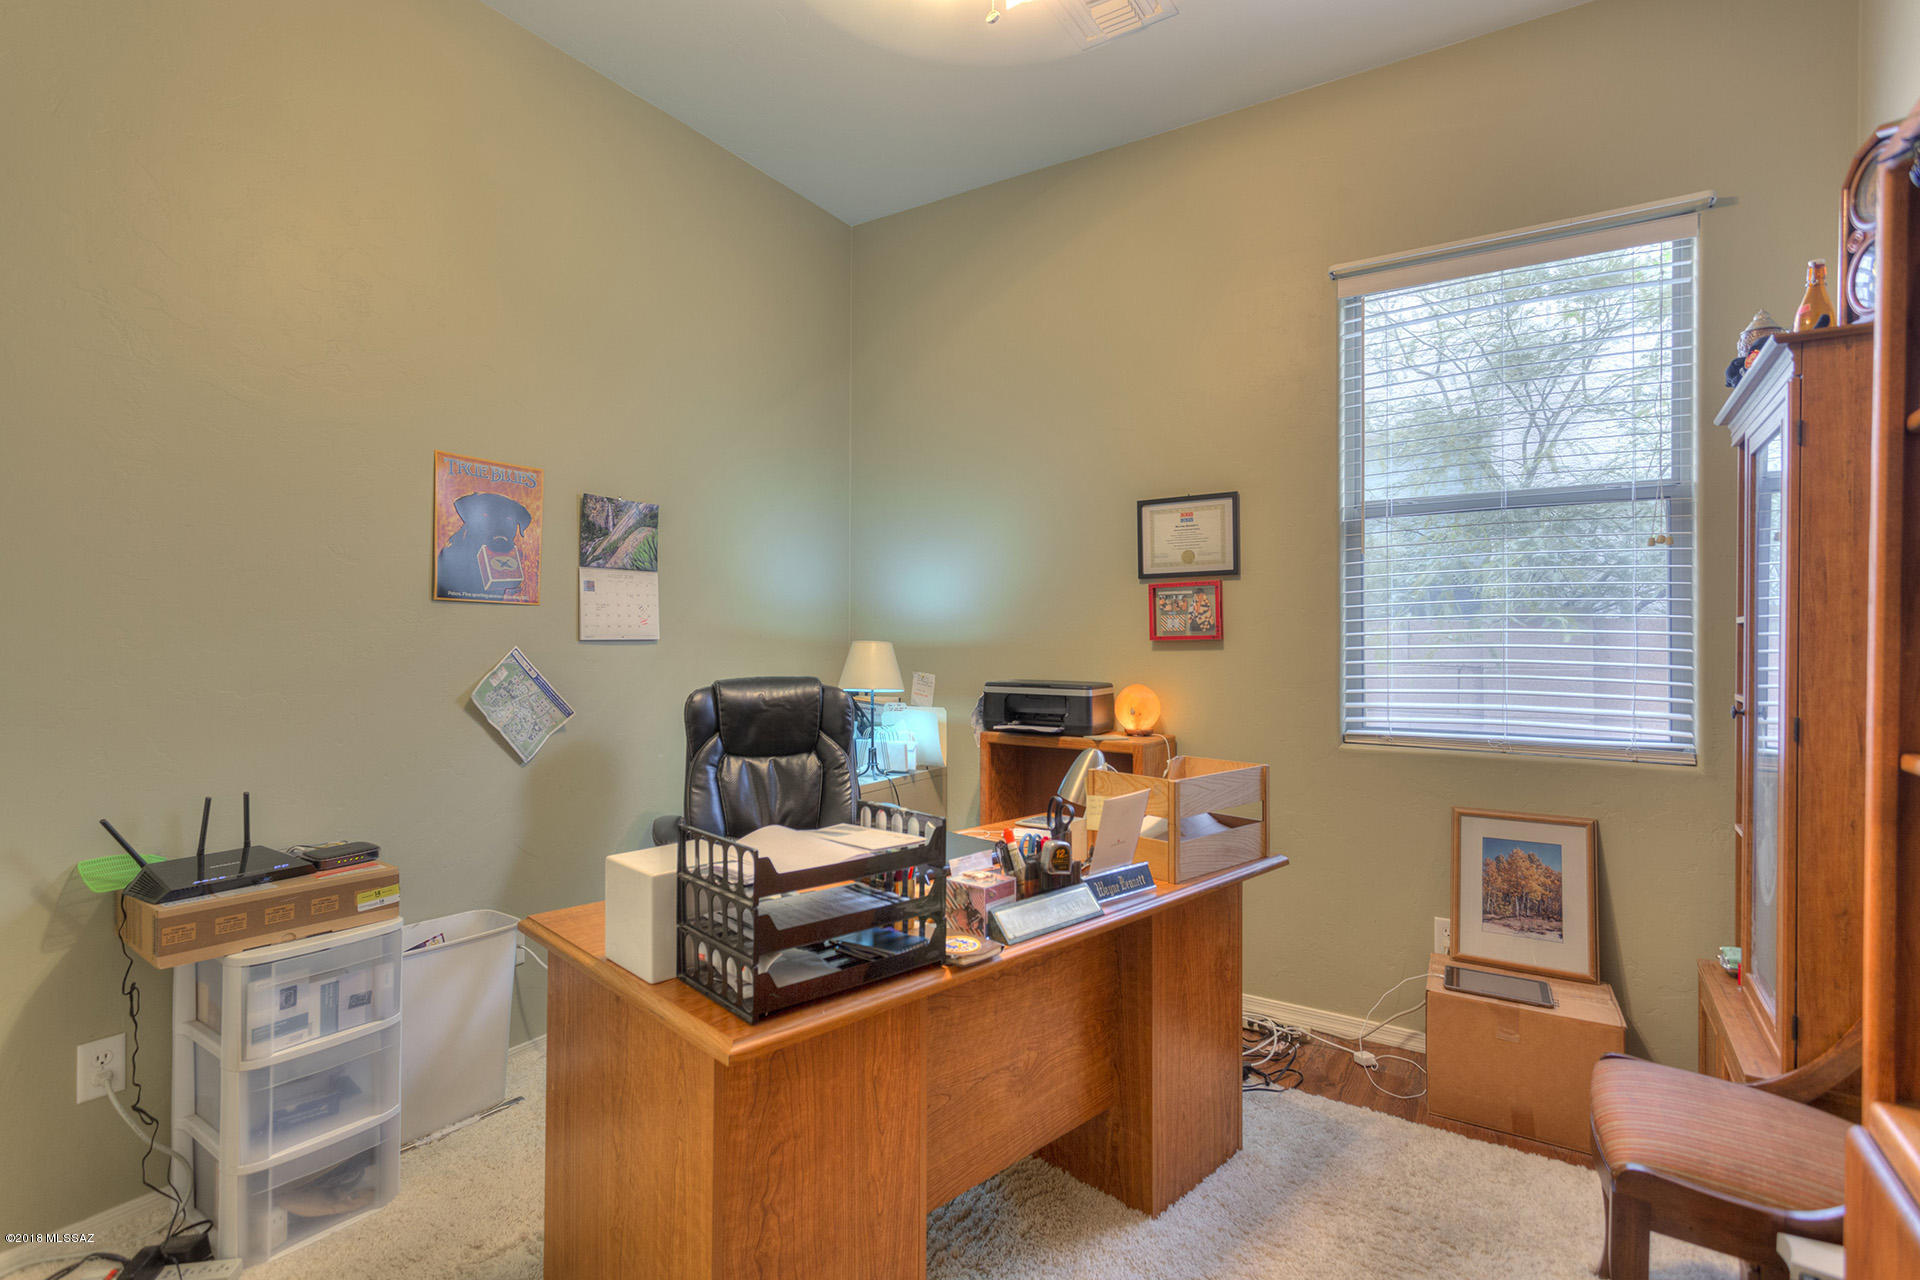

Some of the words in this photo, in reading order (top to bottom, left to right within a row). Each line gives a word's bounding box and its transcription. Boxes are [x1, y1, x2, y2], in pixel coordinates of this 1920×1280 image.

[444, 457, 489, 479] TRUE
[490, 465, 537, 488] BLUES
[1094, 880, 1120, 897] Wayne
[1118, 875, 1146, 891] Bennett
